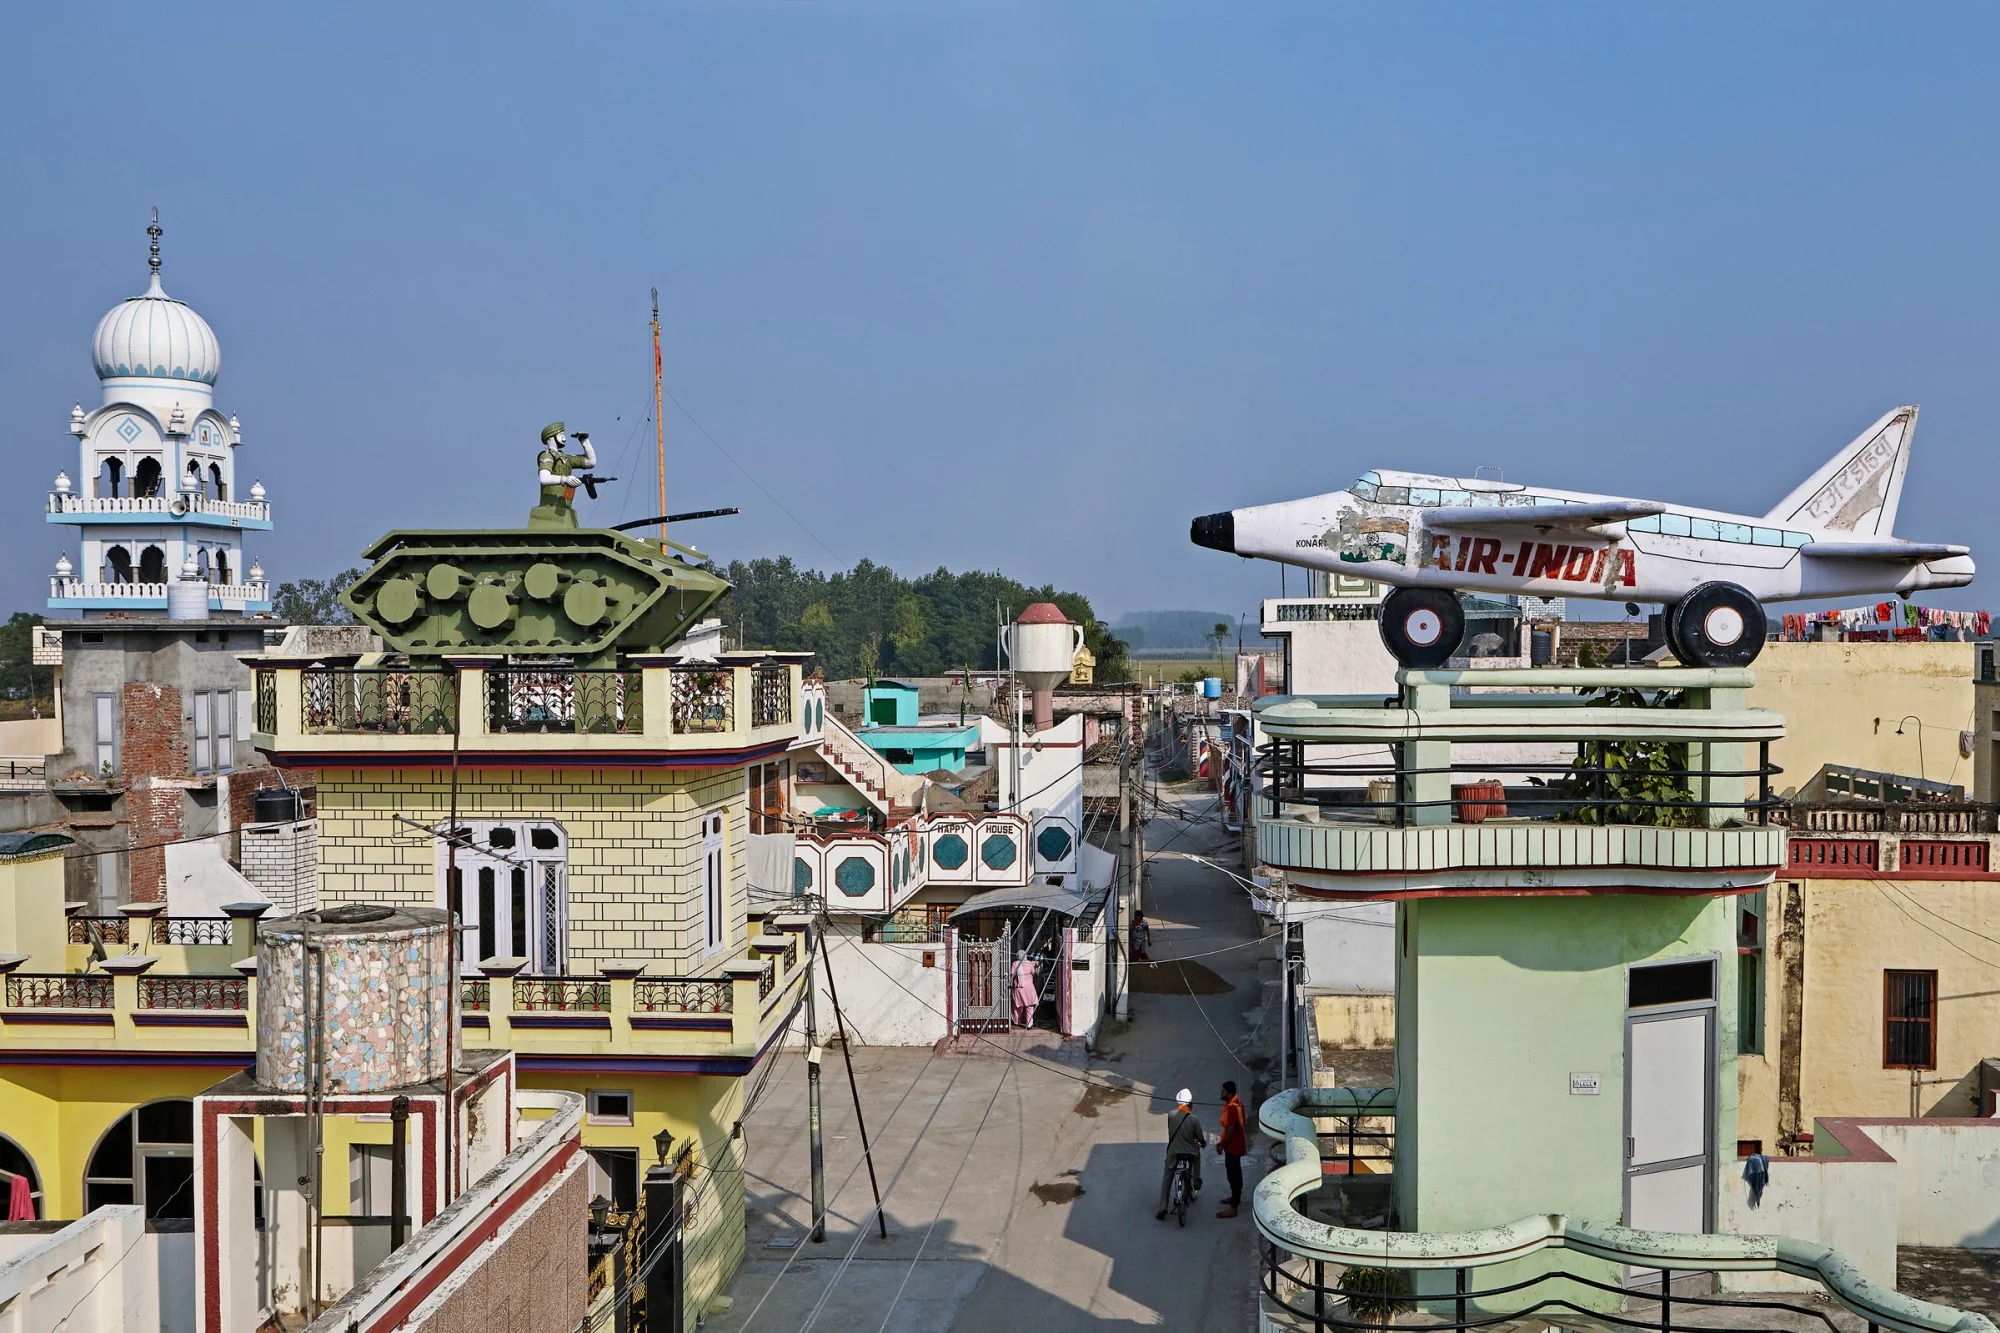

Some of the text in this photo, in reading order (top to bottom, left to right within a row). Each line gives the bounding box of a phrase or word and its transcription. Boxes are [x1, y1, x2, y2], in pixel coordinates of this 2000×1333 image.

[1421, 536, 1636, 586] AIR-INDIA
[937, 824, 1013, 834] HAPPY HOUSE
